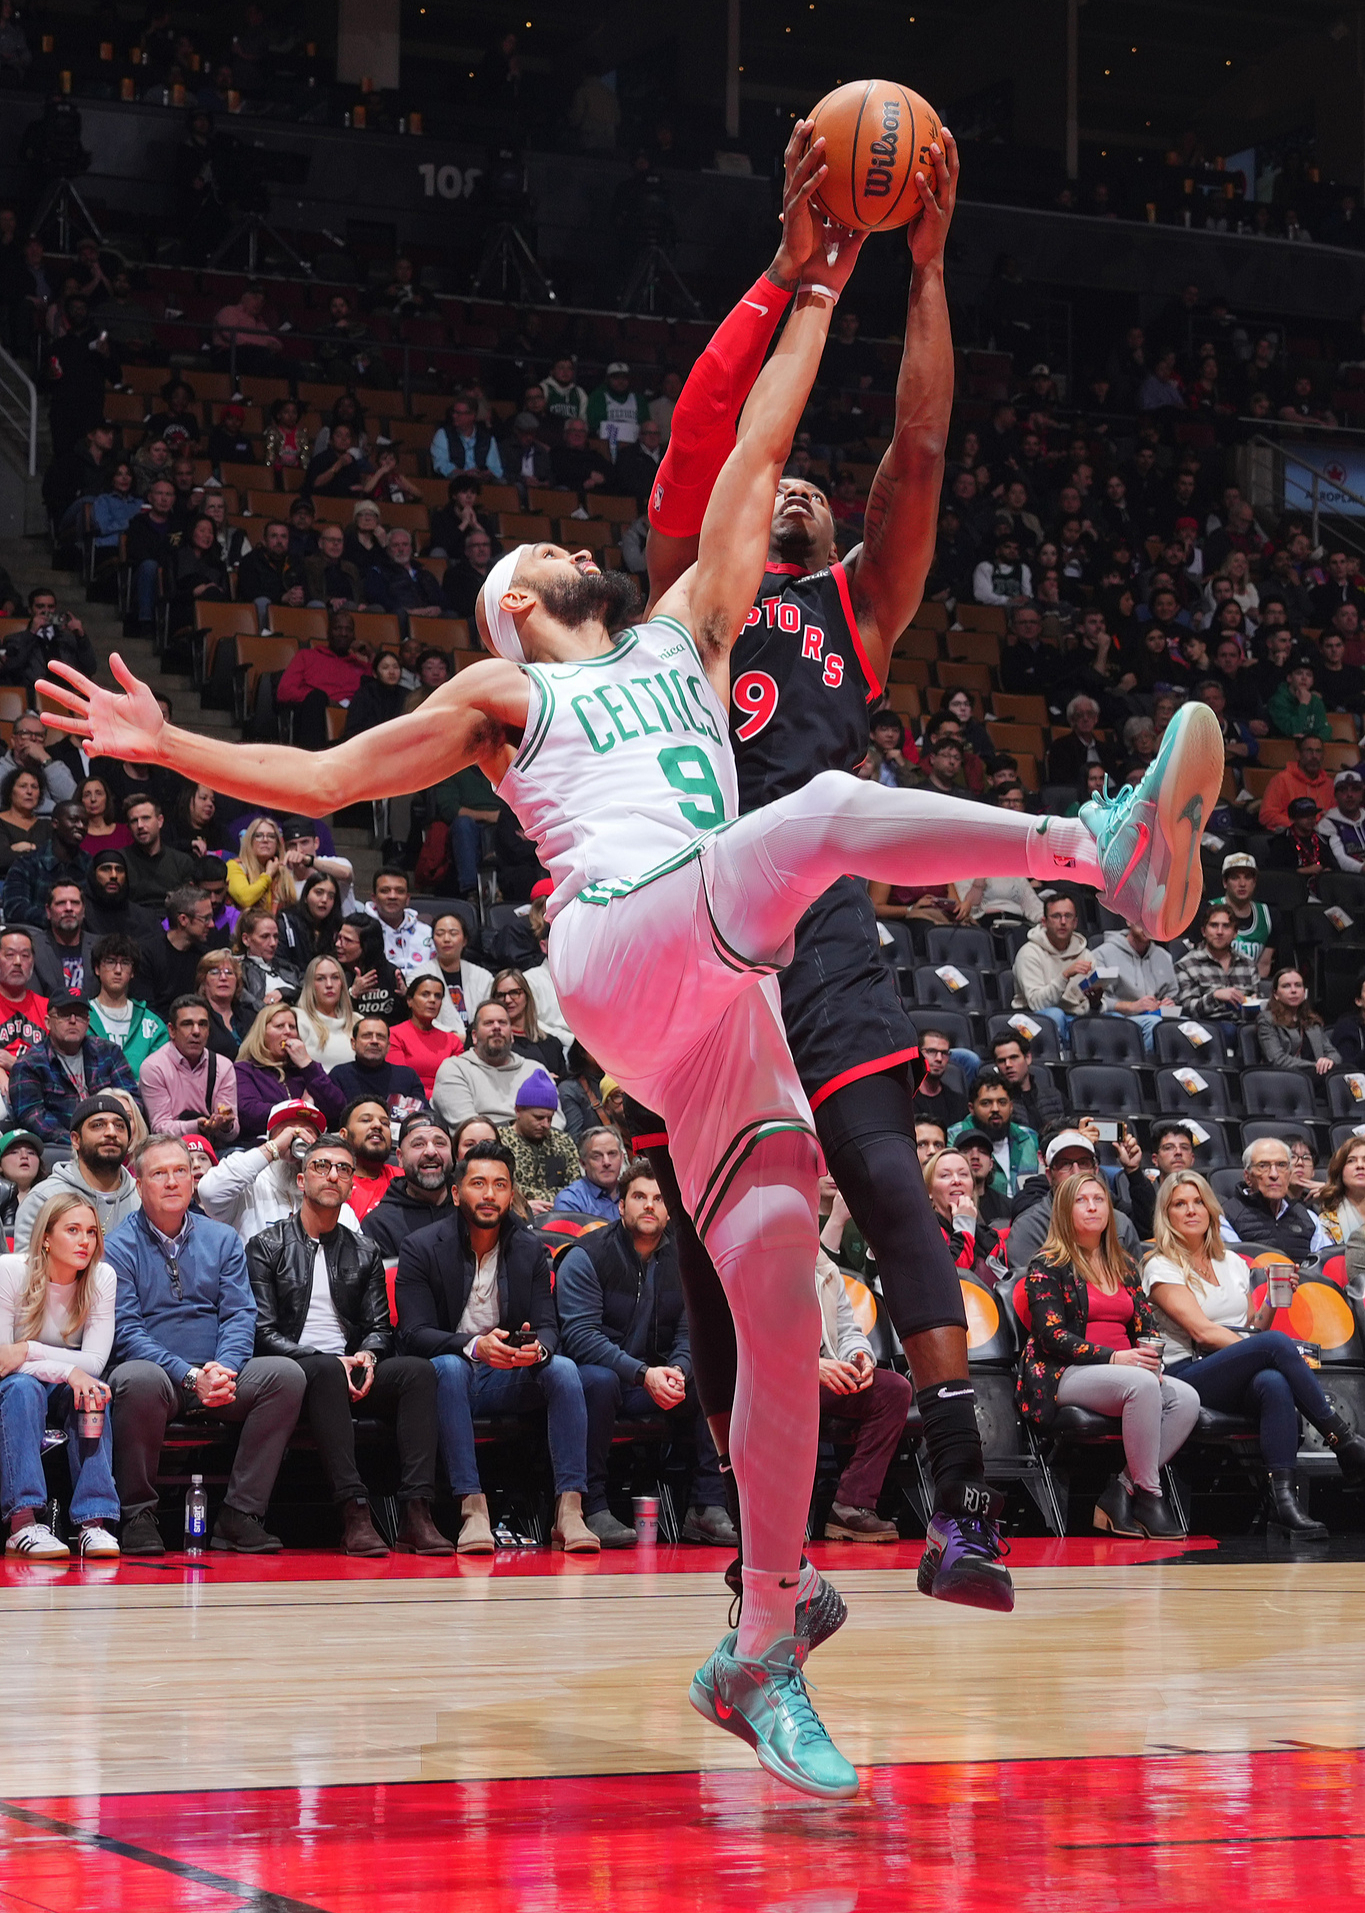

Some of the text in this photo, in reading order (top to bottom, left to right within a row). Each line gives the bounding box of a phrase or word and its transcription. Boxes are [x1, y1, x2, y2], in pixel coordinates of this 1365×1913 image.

[864, 101, 901, 198] Wilson
[571, 669, 723, 754] CELTICS
[732, 670, 779, 742] 9
[657, 745, 725, 830] 9
[193, 1505, 202, 1533] smart
